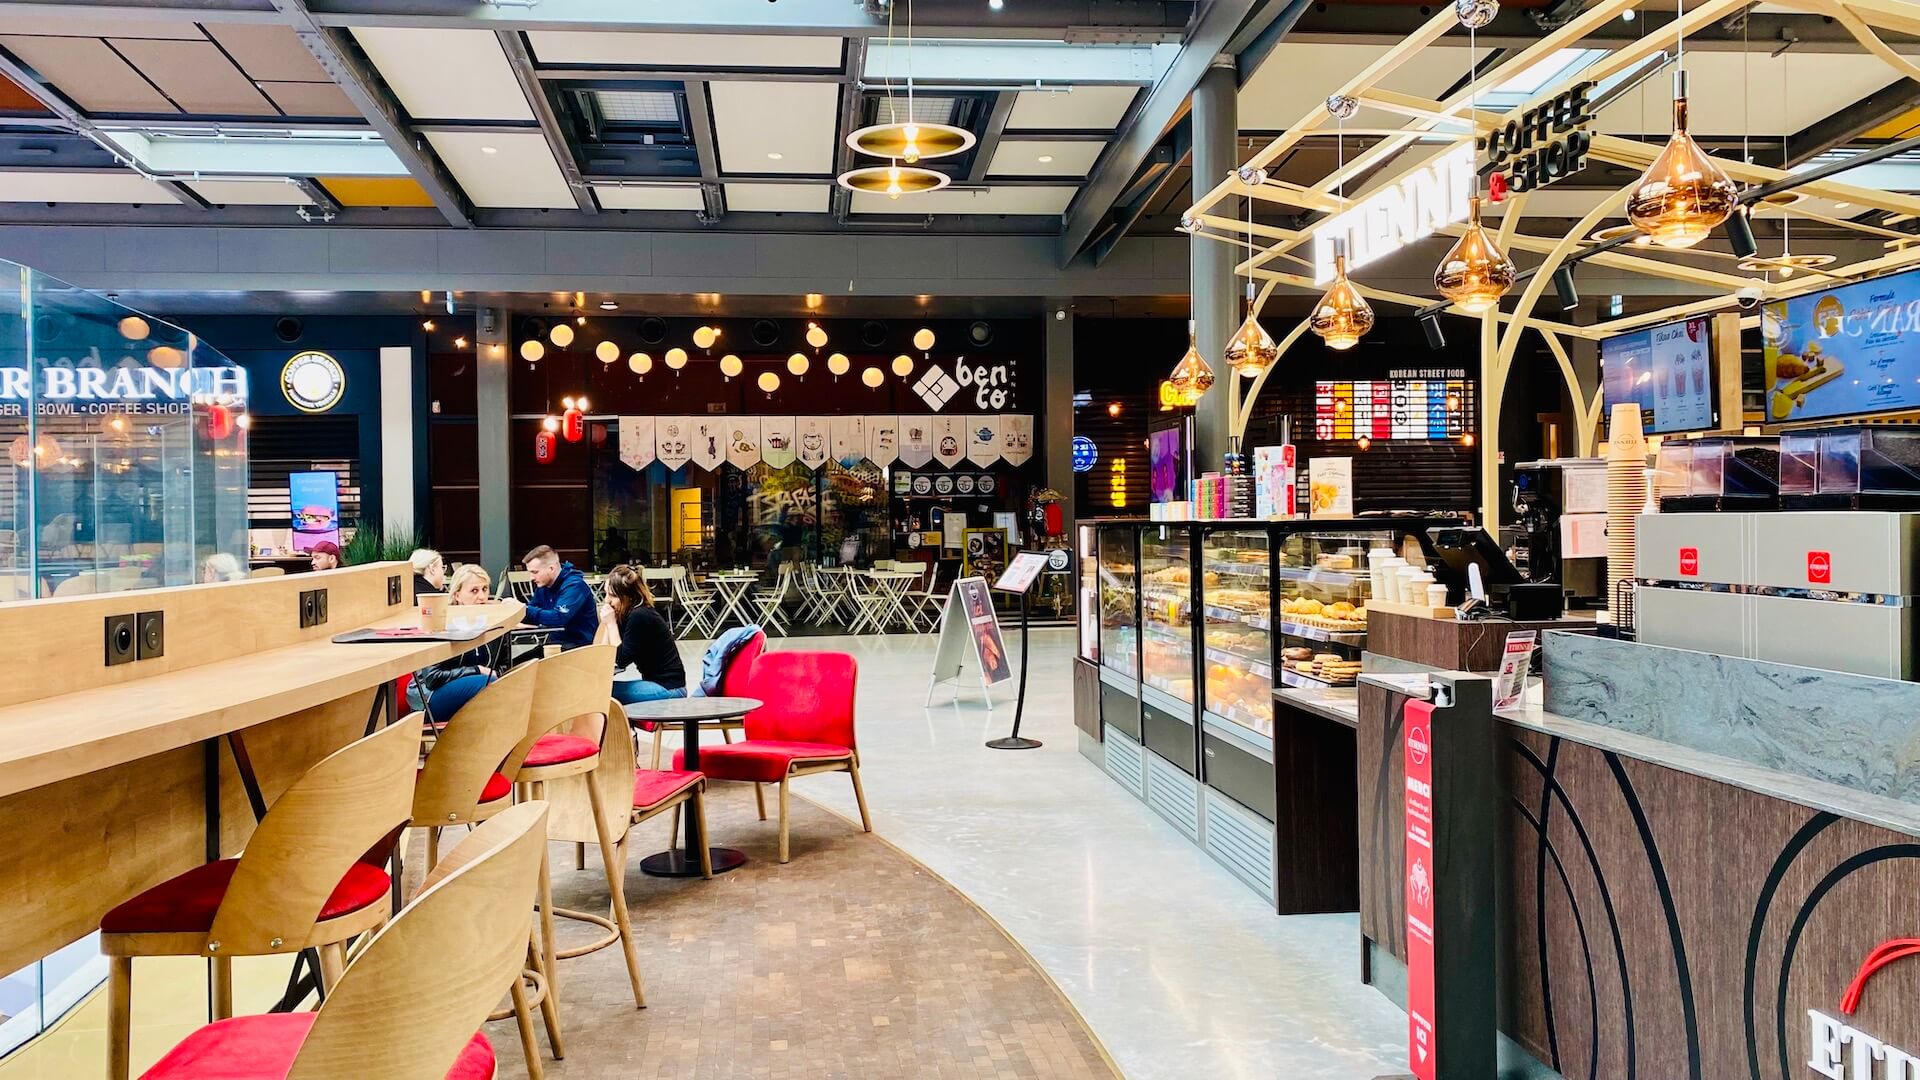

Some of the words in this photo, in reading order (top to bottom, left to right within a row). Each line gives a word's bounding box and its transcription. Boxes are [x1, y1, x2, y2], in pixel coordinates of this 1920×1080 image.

[1488, 81, 1593, 163] COFFEE
[1488, 171, 1508, 202] &
[1511, 131, 1591, 193] SHOP
[1313, 140, 1476, 287] ETIENNE
[43, 366, 247, 400] BRANCH
[955, 356, 1007, 388] ben
[1009, 360, 1017, 409] MANIA
[1389, 369, 1418, 379] KOREAN
[1418, 369, 1446, 379] STREET
[1446, 368, 1466, 378] FOOD
[89, 403, 142, 415] COFFEE
[147, 402, 191, 415] SHOP
